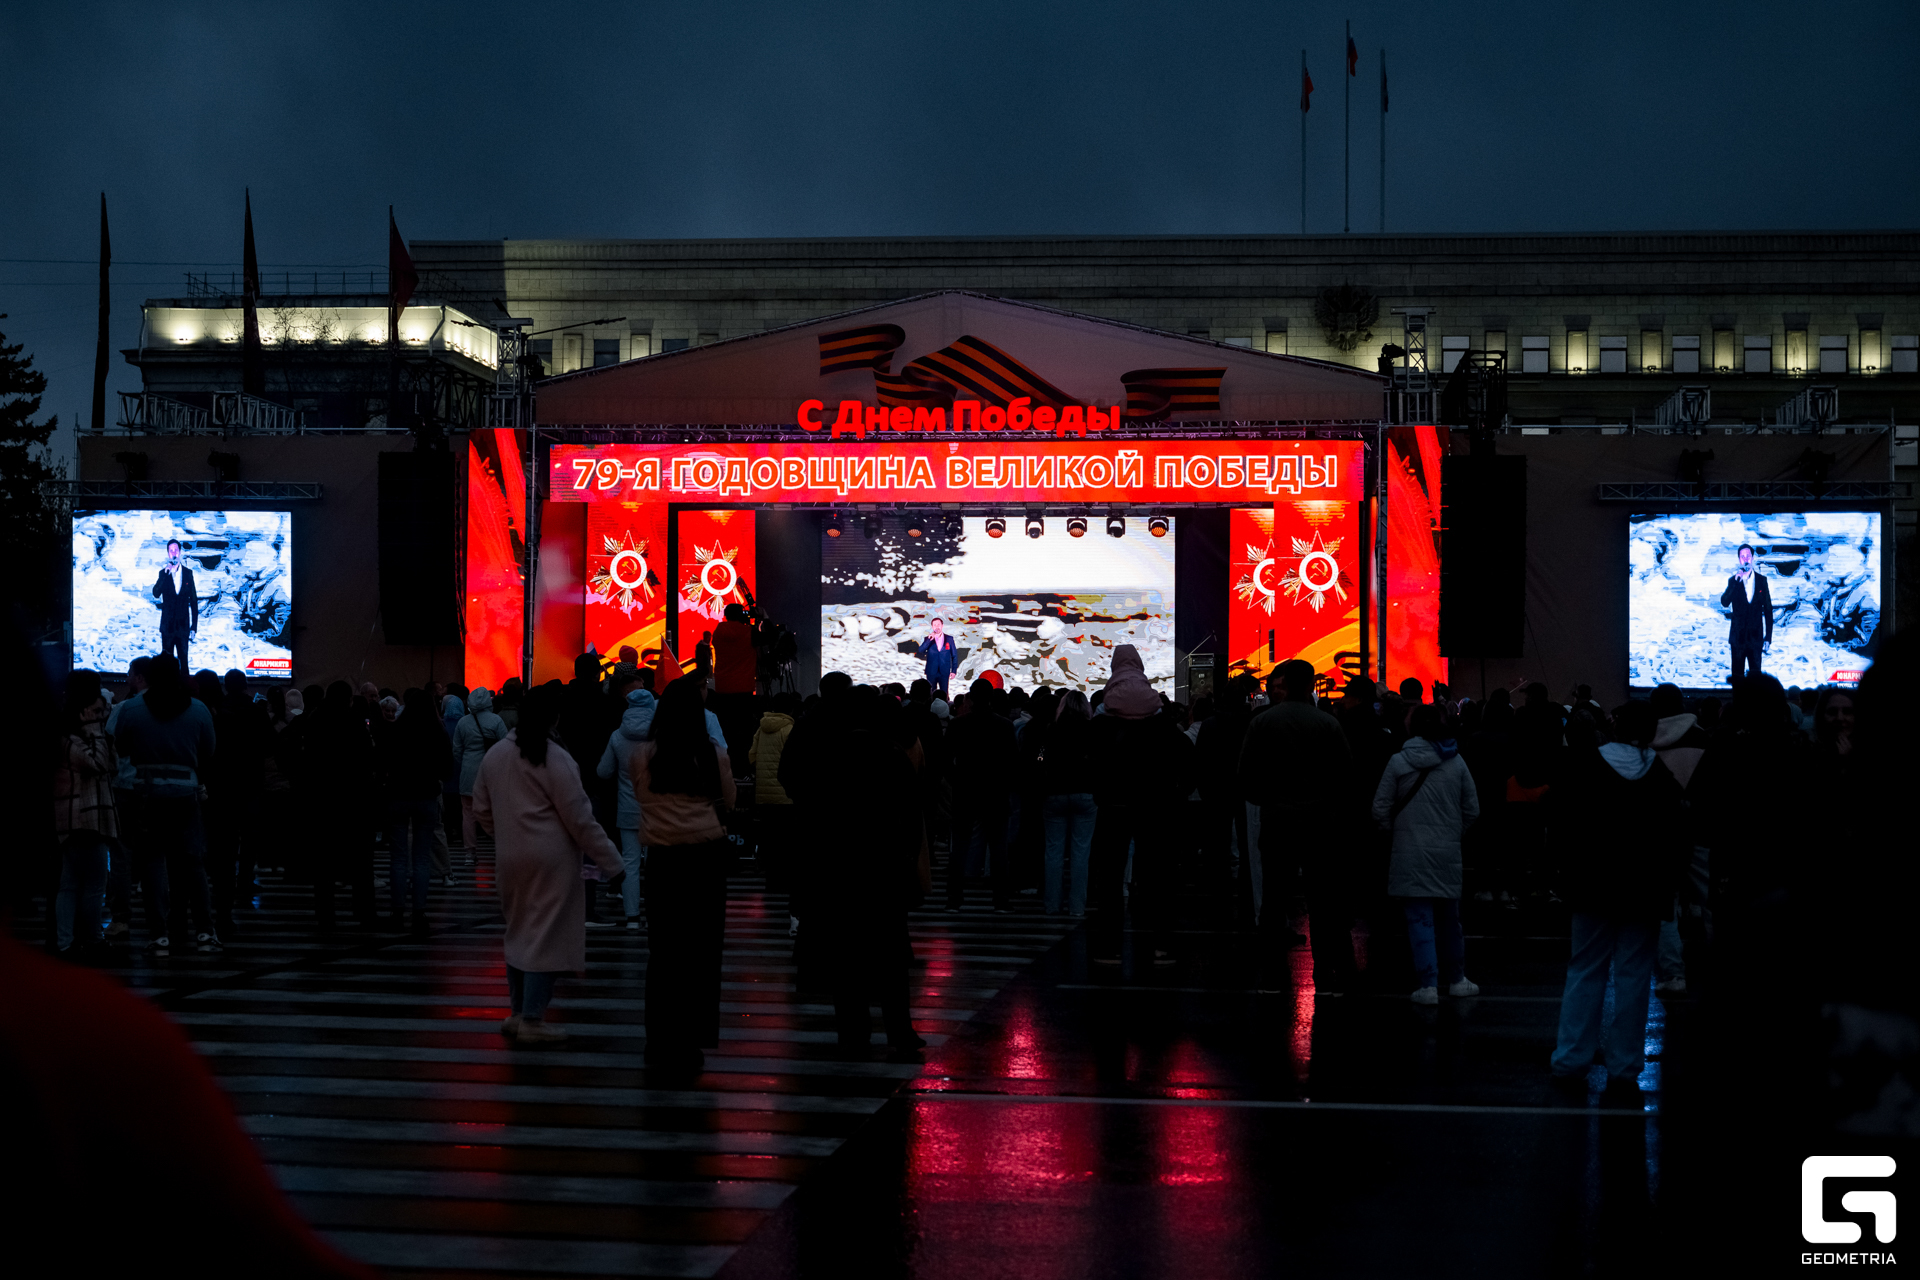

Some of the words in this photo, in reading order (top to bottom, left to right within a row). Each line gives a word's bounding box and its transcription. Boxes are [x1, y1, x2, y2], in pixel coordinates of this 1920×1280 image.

[797, 399, 824, 431] С
[831, 400, 946, 439] Днем
[953, 396, 1120, 438] Победы
[573, 457, 660, 490] 79-Я
[672, 456, 935, 496] ГОДОВЩИНА
[946, 449, 1144, 489] ВЕЛИКОЙ
[1156, 454, 1338, 494] ПОБЕДЫ
